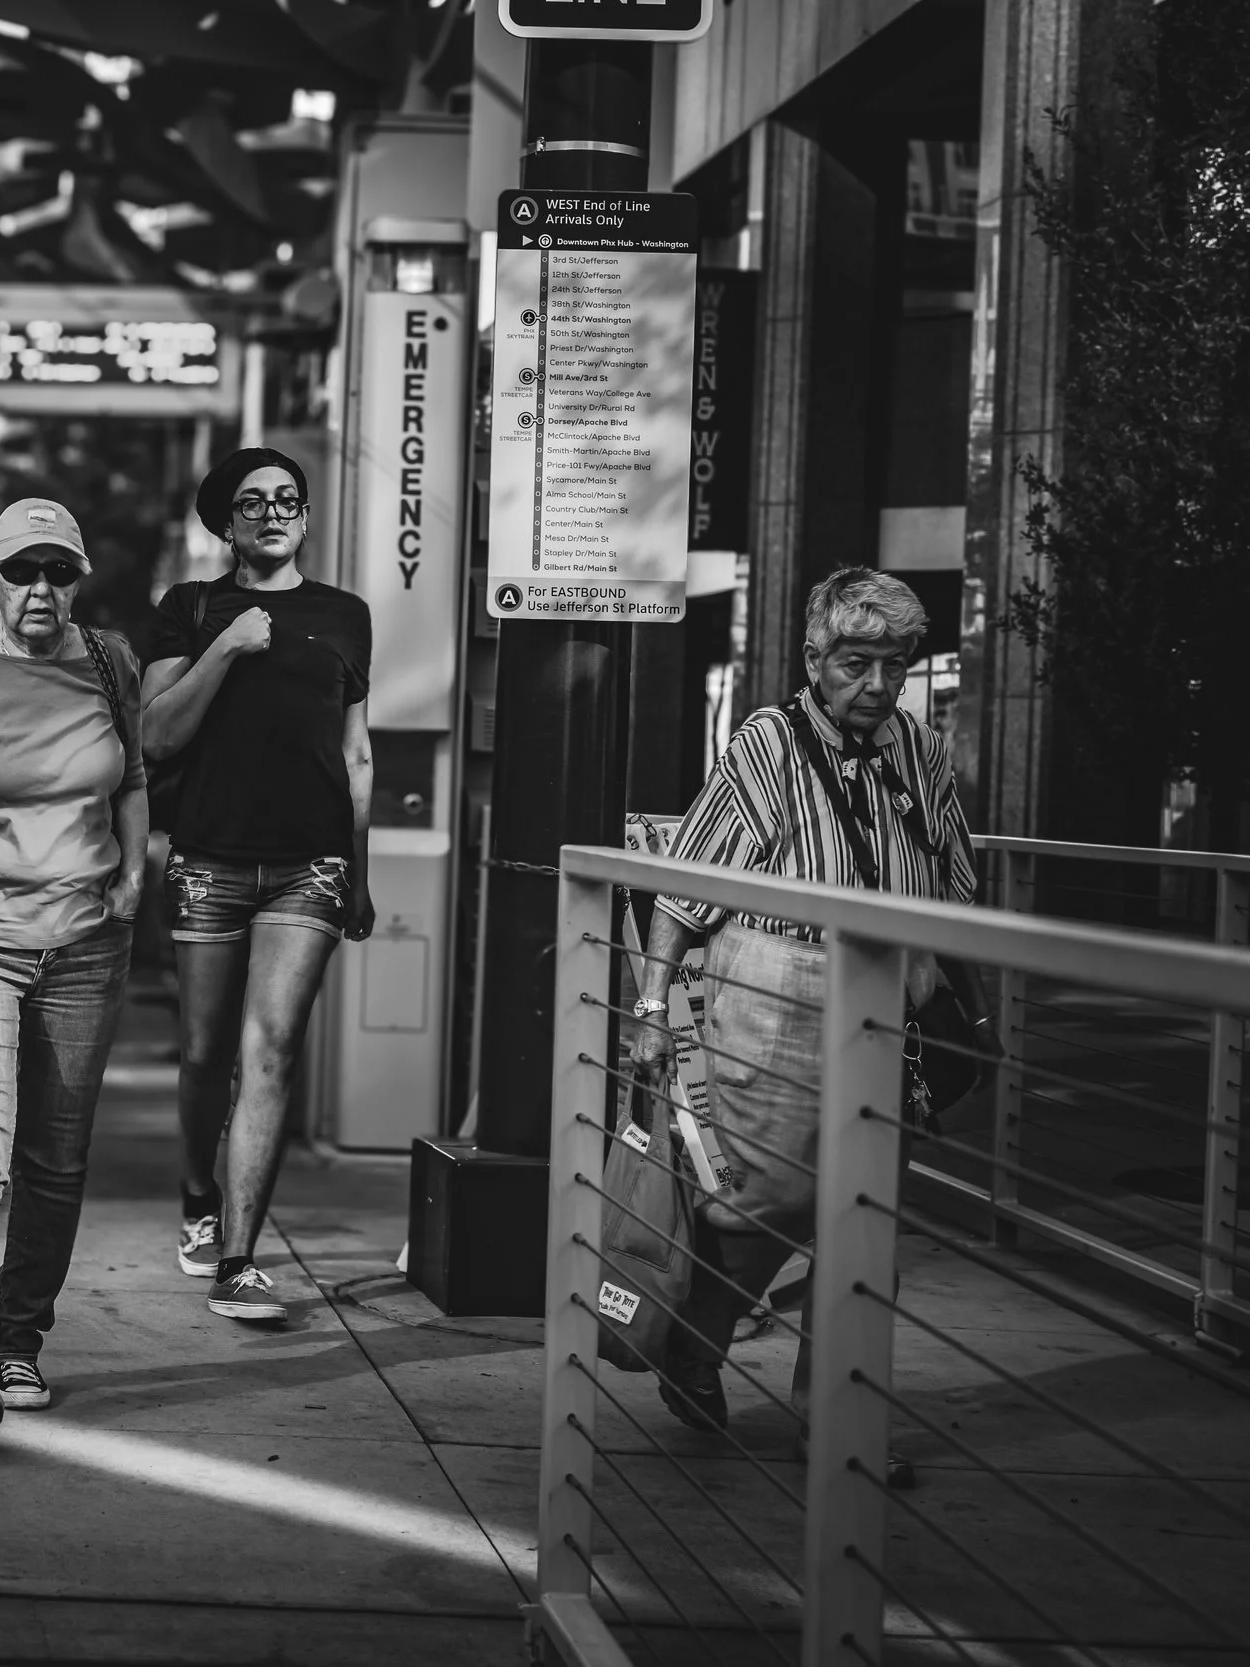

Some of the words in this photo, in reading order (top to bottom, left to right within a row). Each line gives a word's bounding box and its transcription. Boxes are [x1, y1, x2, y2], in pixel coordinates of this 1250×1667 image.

[546, 199, 580, 210] WEST
[584, 200, 605, 211] End
[610, 200, 622, 211] of
[626, 201, 650, 212] Line
[546, 214, 592, 225] Arrivals
[596, 215, 624, 228] Only
[601, 239, 616, 247] Phx
[618, 239, 634, 247] Hub
[642, 241, 688, 249] Washington
[569, 257, 618, 265] St/Jefferson
[552, 271, 569, 279] 12th
[572, 272, 620, 280] St/Jefferson
[572, 286, 622, 294] St/Jefferson
[572, 301, 630, 310] St/Washington
[572, 316, 631, 325] St/Washington
[572, 331, 630, 339] St/Washington
[575, 345, 634, 354] Dr/Washington
[578, 360, 648, 369] Pkwy/Washington
[586, 390, 634, 399] Way/College
[636, 390, 651, 398] Ave
[549, 403, 587, 412] University
[548, 418, 608, 427] Dorsey/Apache
[548, 433, 621, 442] McClintock/Apache
[398, 310, 428, 590] EMERGENCY
[547, 447, 631, 457] Smith-Martin/Apache
[584, 462, 632, 471] Fwy/Apache
[634, 463, 651, 471] Blvd
[546, 476, 607, 485] Sycamore/Main
[692, 431, 720, 539] WOLF
[568, 492, 616, 500] School/Main
[546, 506, 576, 515] Country
[579, 506, 618, 514] Club/Main
[545, 520, 593, 528] Center/Main
[568, 535, 599, 543] Dr/Main
[545, 549, 573, 558] Stapley
[576, 550, 607, 558] Dr/Main
[609, 550, 617, 558] St
[544, 564, 571, 572] Gilbert
[528, 586, 547, 596] For
[551, 587, 626, 598] EASTBOUND
[528, 601, 549, 611] Use
[554, 602, 609, 613] Jefferson
[613, 603, 625, 613] St
[629, 603, 680, 615] Platform
